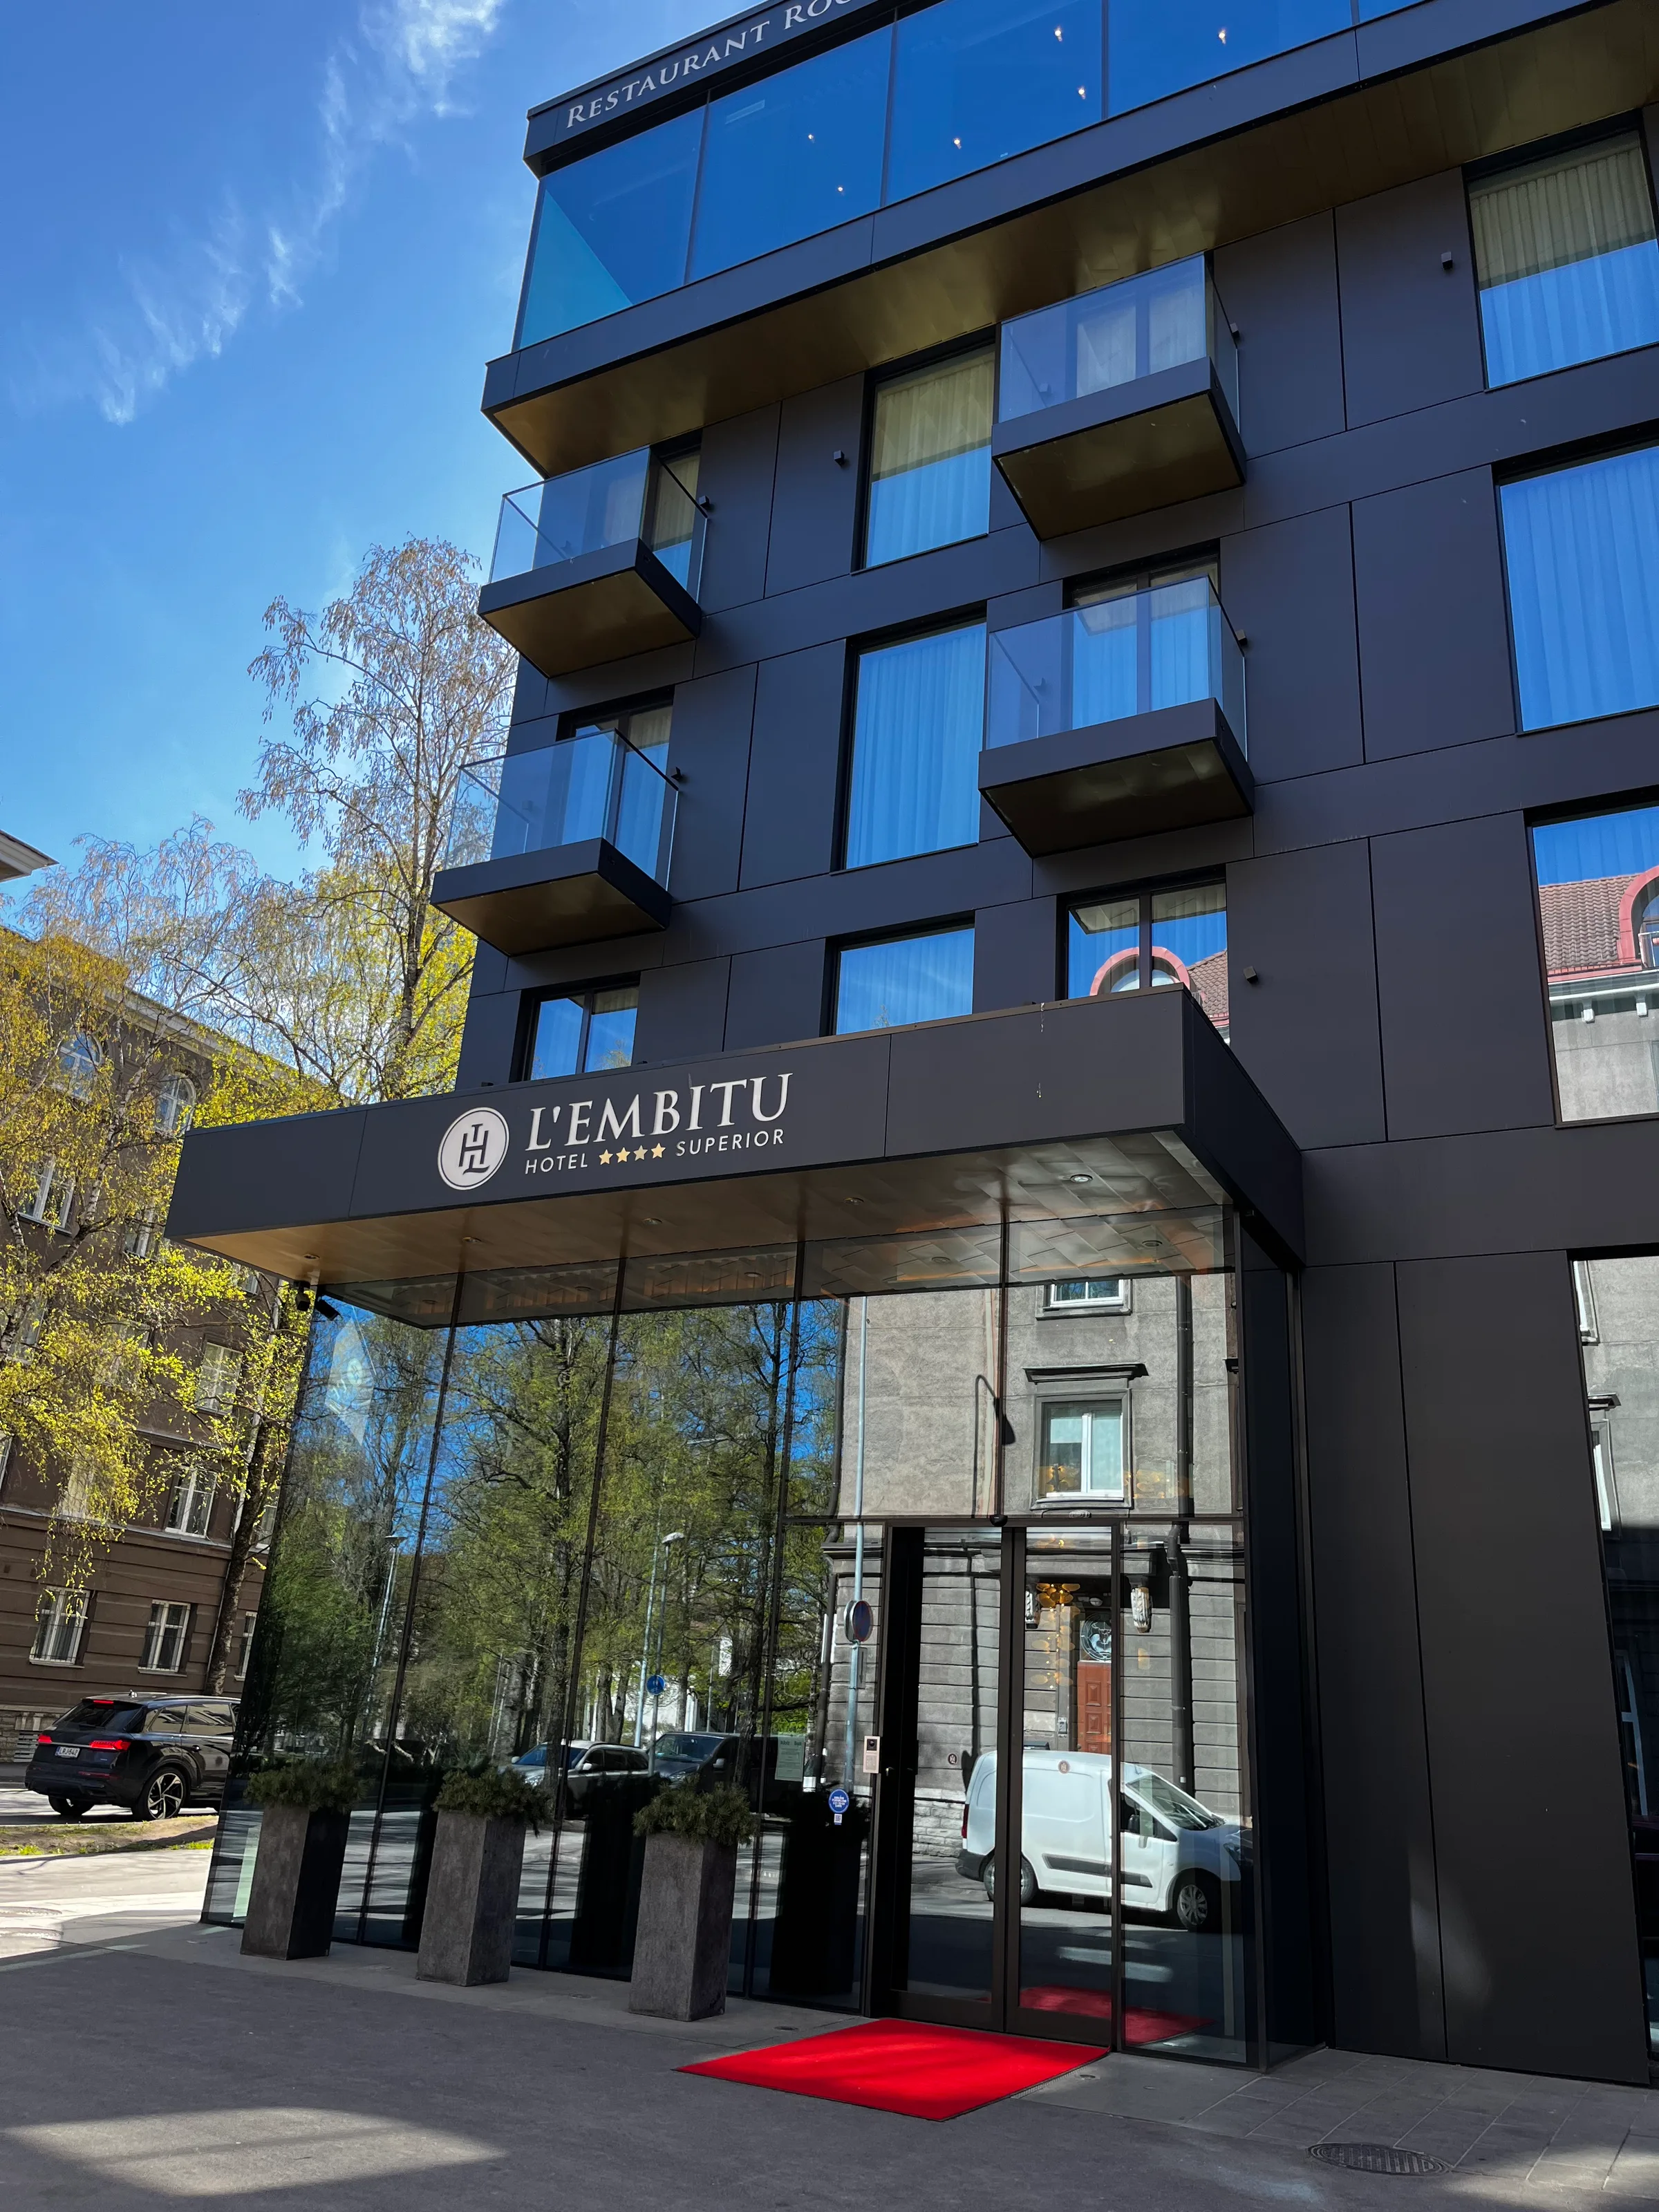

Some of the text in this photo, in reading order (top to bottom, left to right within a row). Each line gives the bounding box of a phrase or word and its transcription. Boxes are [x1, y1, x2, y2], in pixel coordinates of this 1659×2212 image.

[566, 0, 852, 129] RESTAURANT RO
[525, 1073, 794, 1152] L'EMBITU
[525, 1128, 785, 1174] HOTEL SUPERIOR
